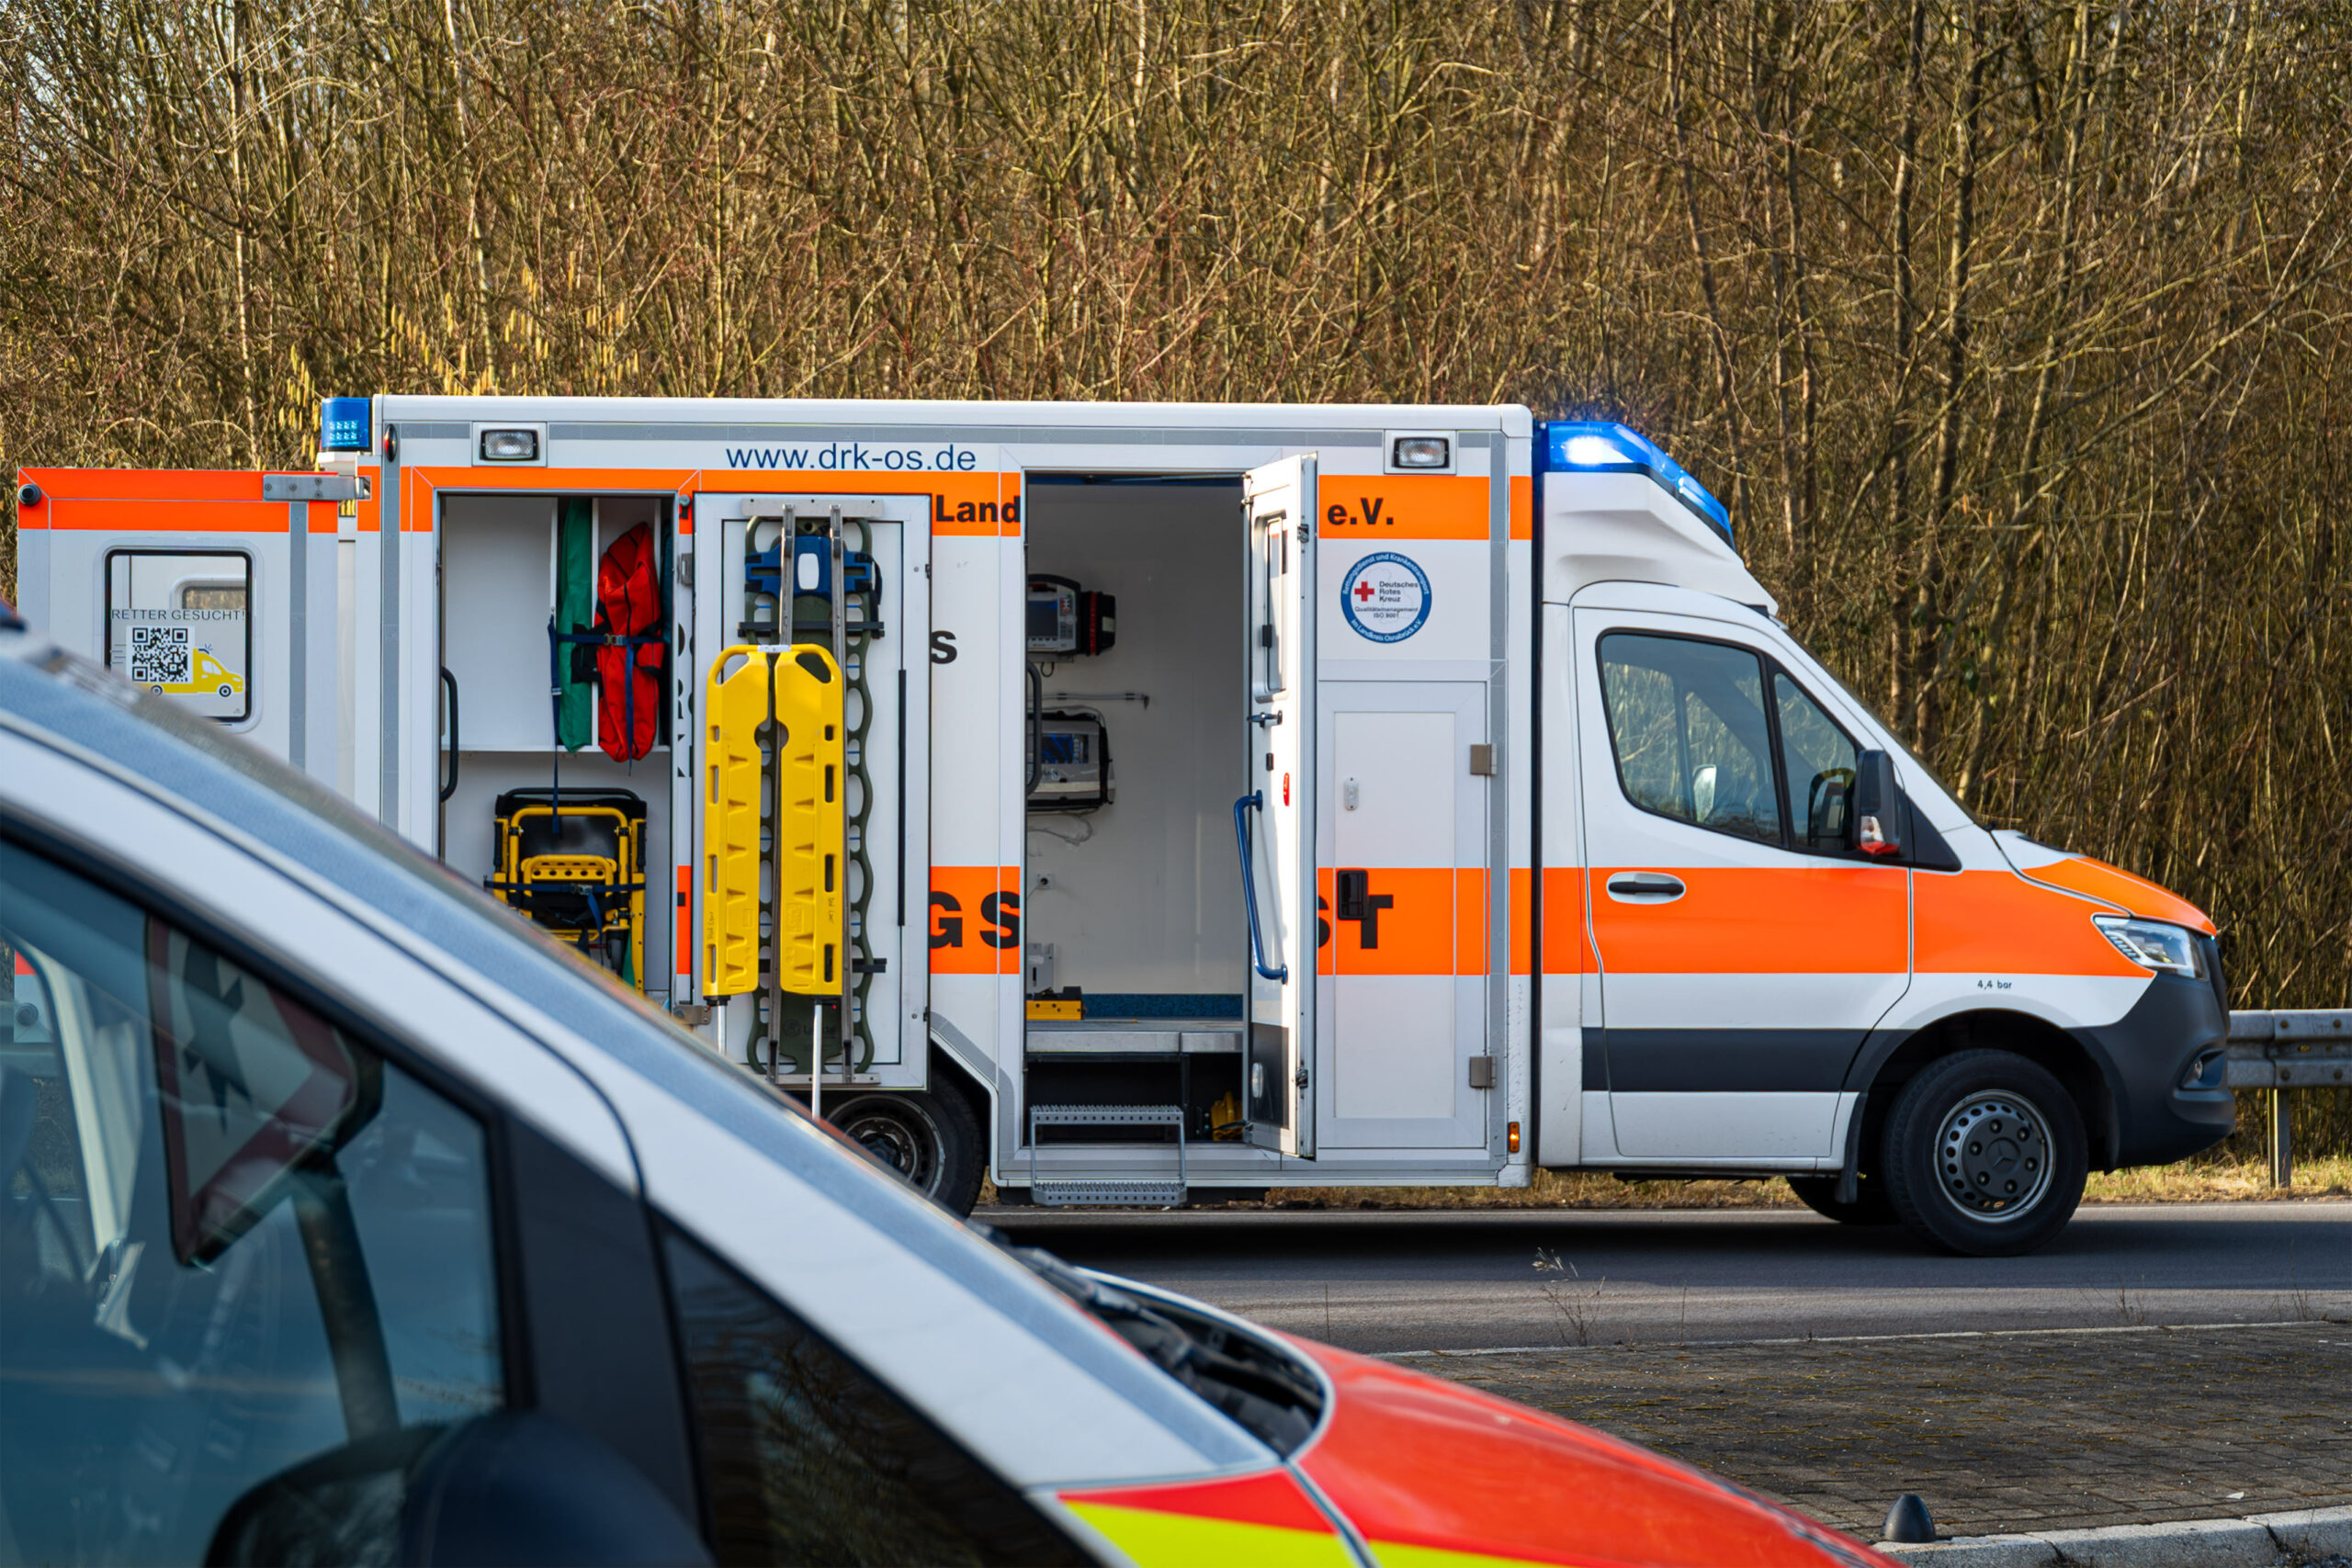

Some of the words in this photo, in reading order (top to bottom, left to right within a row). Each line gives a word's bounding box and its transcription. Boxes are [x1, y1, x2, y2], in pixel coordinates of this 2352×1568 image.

[726, 443, 976, 470] www.drk-os.de
[1328, 498, 1394, 525] e.V.
[111, 609, 167, 620] RETTER
[171, 609, 245, 621] GESUCHT!
[1977, 979, 1993, 990] 4,4
[1996, 979, 2012, 989] bar
